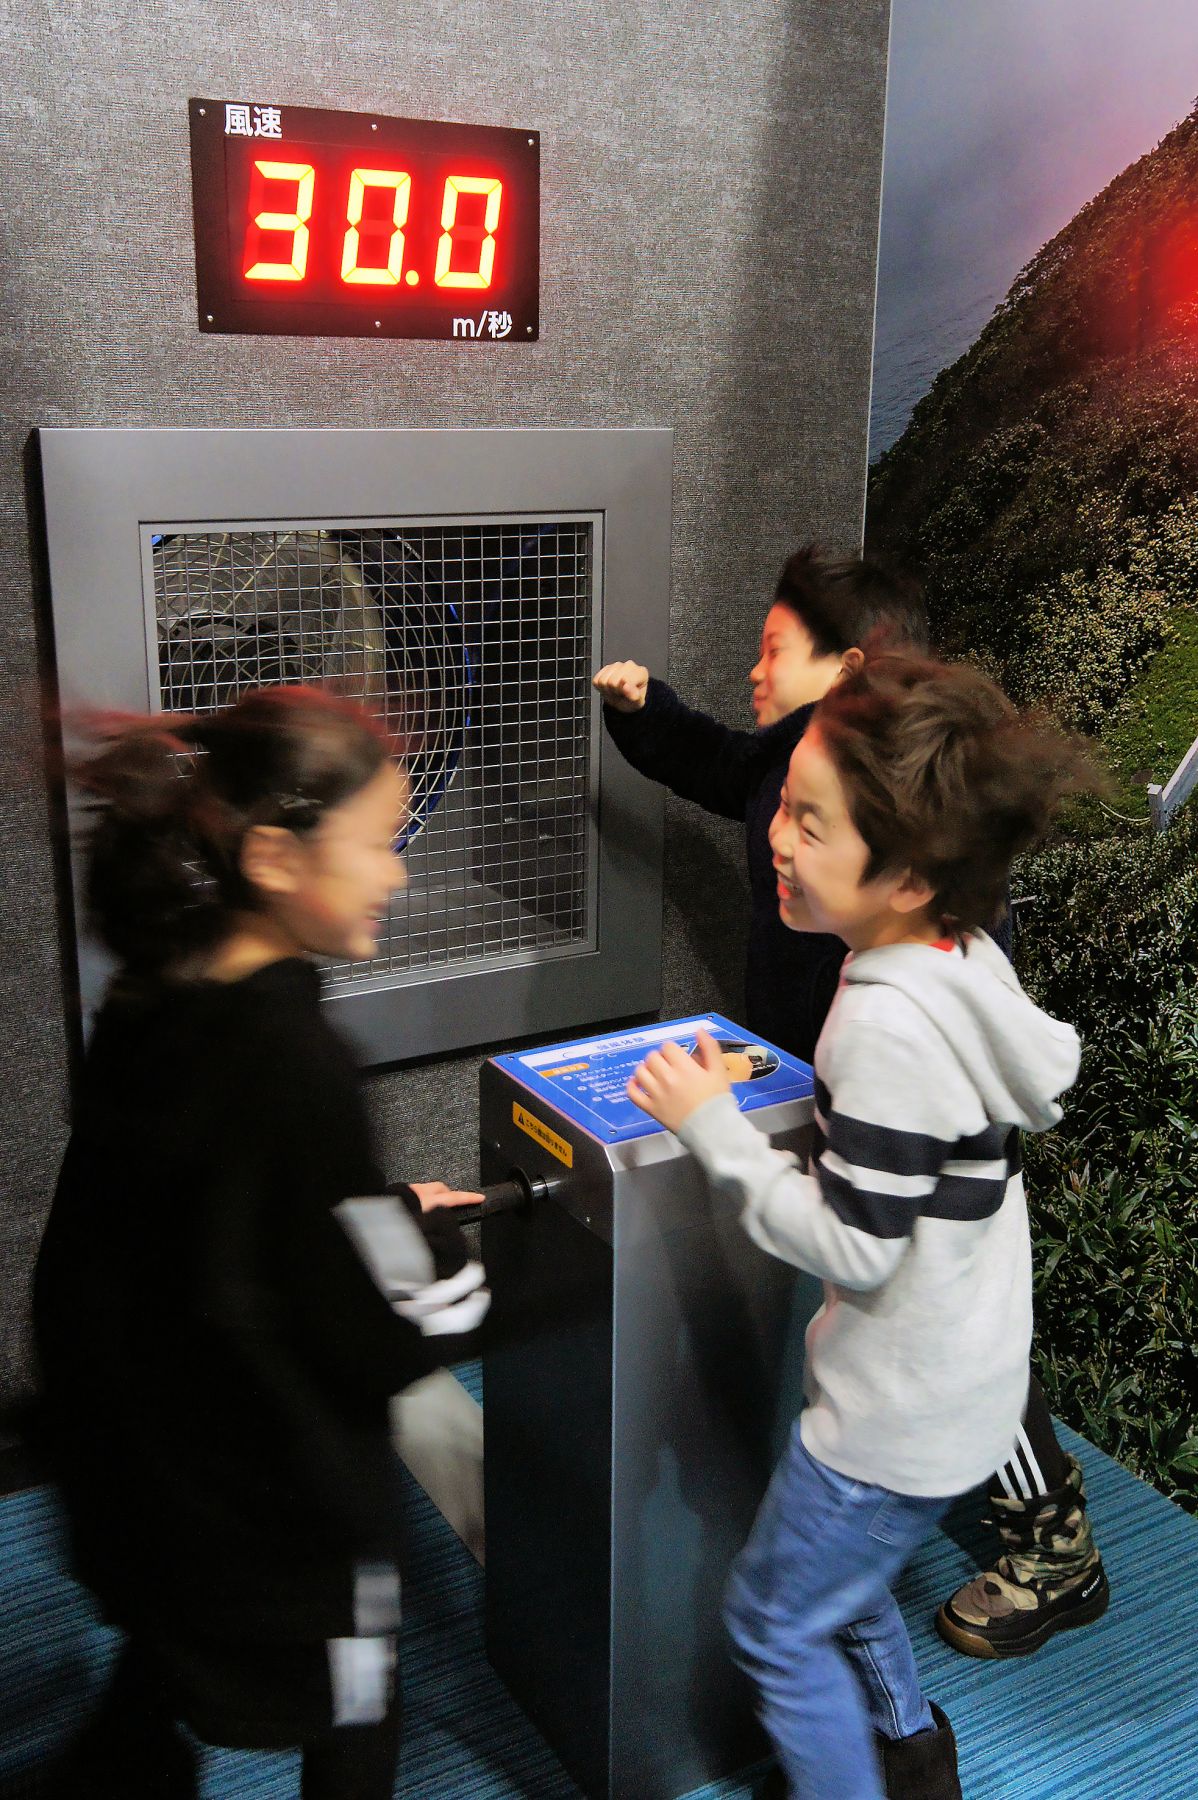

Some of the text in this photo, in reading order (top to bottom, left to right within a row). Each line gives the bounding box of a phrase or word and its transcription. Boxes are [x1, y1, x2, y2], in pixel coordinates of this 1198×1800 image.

[224, 104, 282, 139] 風速
[245, 160, 502, 289] 30.0
[452, 310, 513, 338] m/秒
